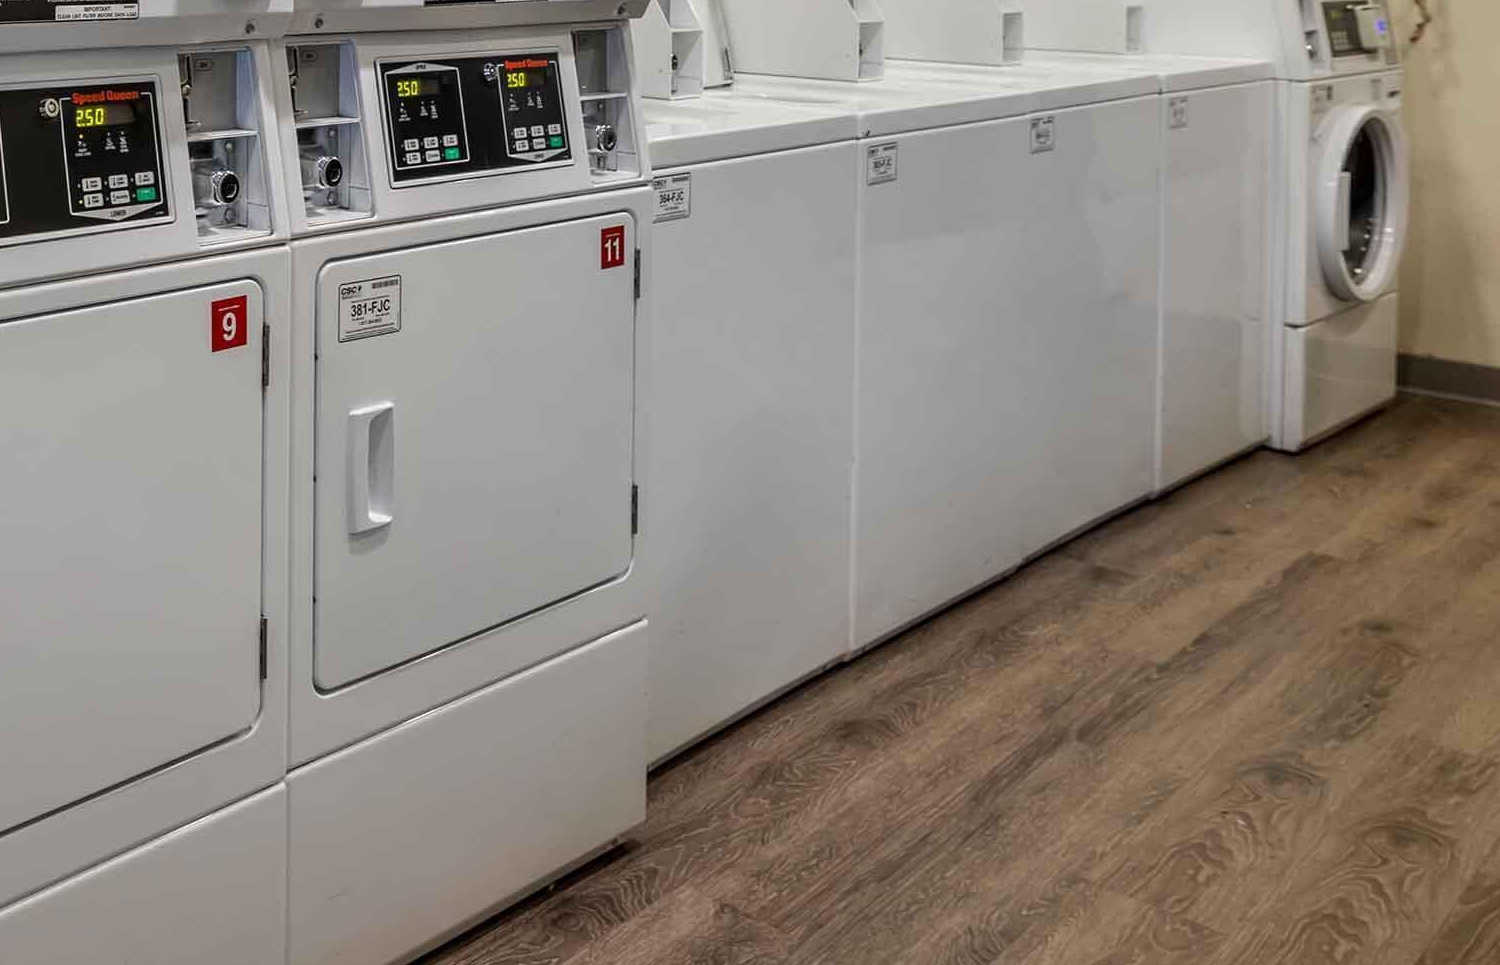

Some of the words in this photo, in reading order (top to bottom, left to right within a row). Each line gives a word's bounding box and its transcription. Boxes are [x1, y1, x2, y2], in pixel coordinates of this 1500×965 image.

[72, 90, 105, 105] Speed
[106, 90, 139, 101] Queen
[604, 237, 620, 262] 11
[351, 299, 390, 317] 381-FJC
[222, 312, 237, 341] 9
